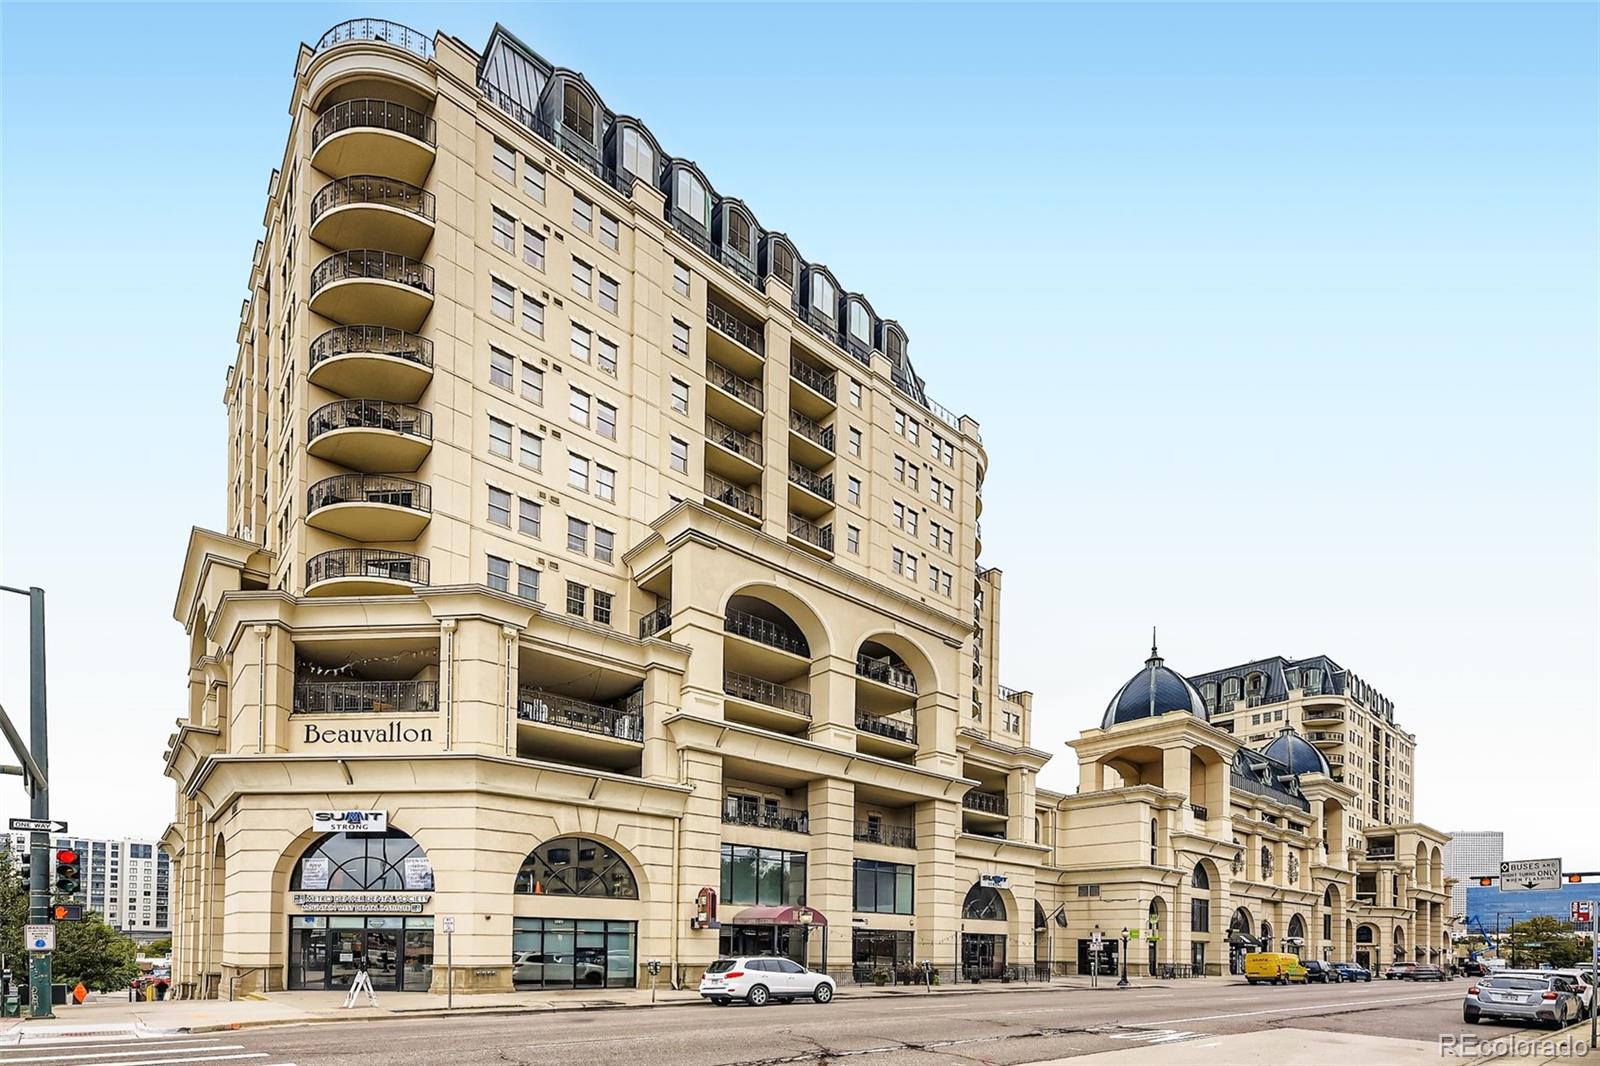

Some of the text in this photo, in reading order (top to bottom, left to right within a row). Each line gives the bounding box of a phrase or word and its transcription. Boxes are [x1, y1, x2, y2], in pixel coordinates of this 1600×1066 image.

[304, 721, 432, 743] Beauvallon
[1511, 863, 1540, 871] BUSES
[1537, 869, 1558, 877] ONLY
[304, 895, 333, 903] METRO
[364, 895, 396, 903] DENTAL
[396, 895, 429, 903] SOCIETY
